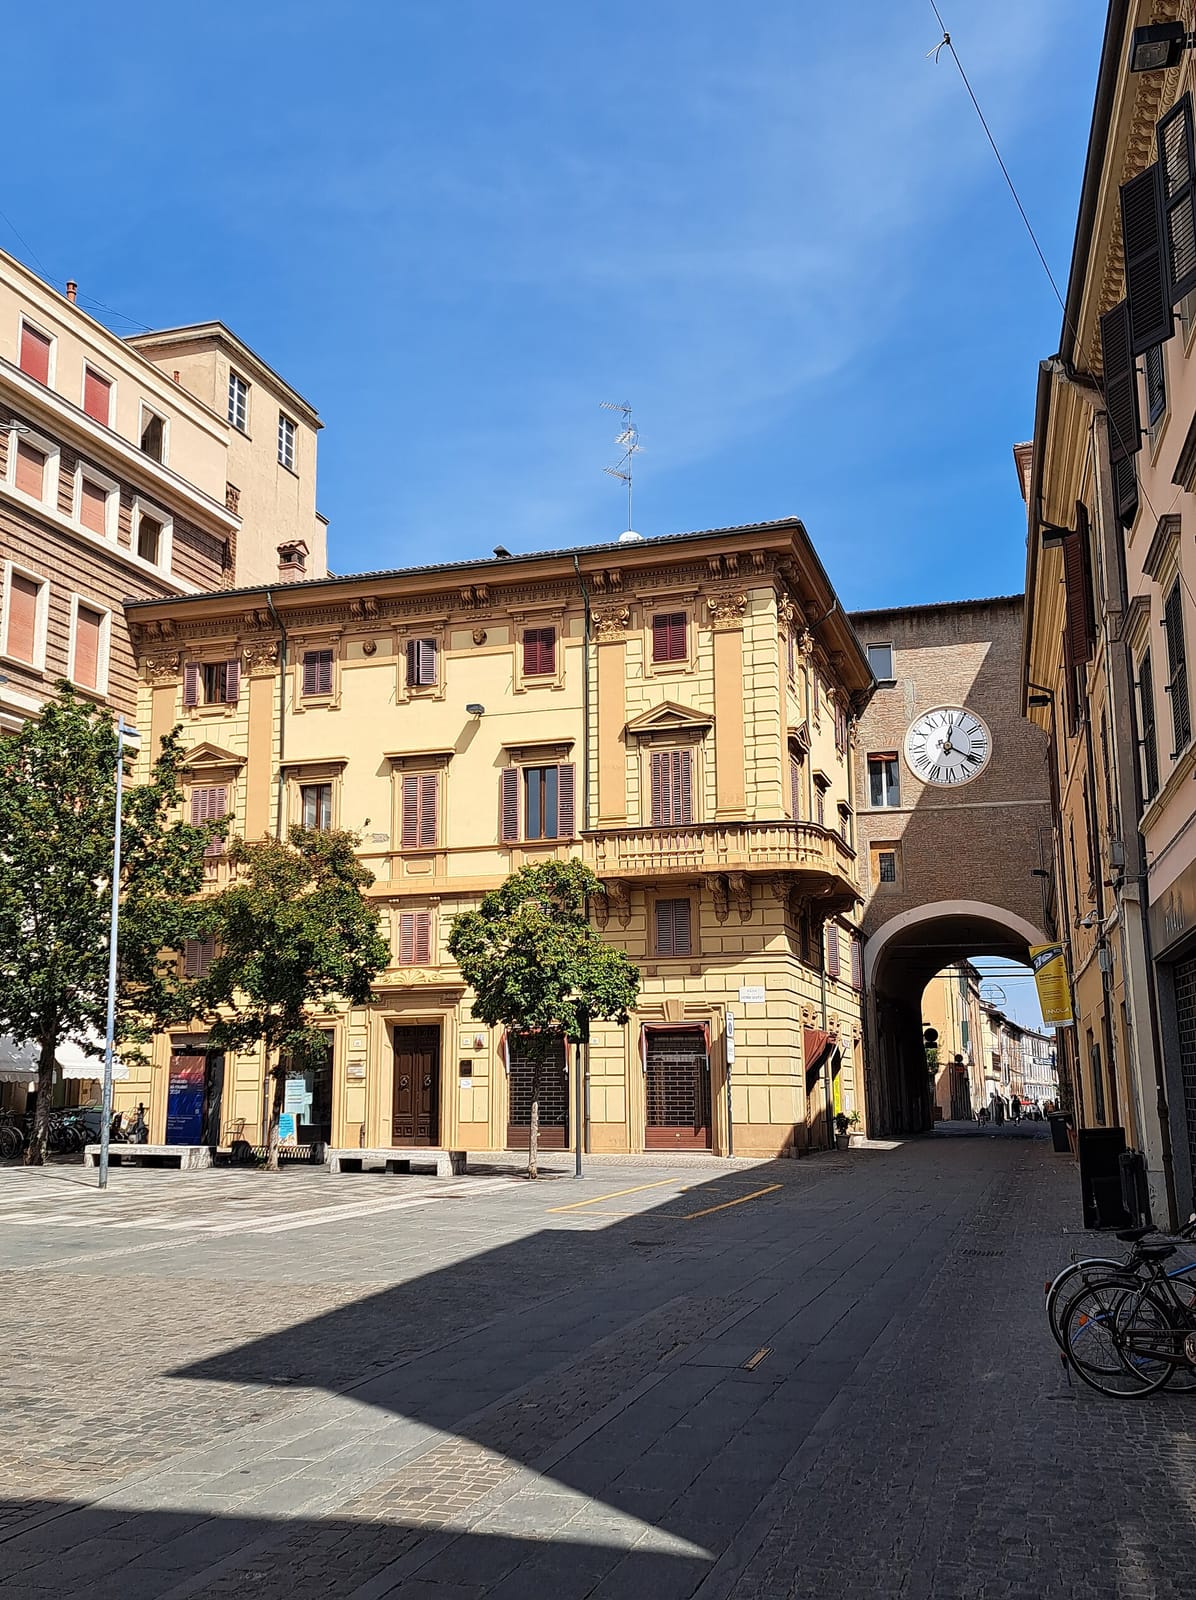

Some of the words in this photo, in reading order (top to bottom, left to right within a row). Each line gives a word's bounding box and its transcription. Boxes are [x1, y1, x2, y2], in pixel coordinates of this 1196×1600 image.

[925, 717, 939, 731] XI
[940, 713, 953, 726] XII
[916, 730, 929, 740] X
[967, 725, 979, 736] II
[971, 740, 984, 749] III
